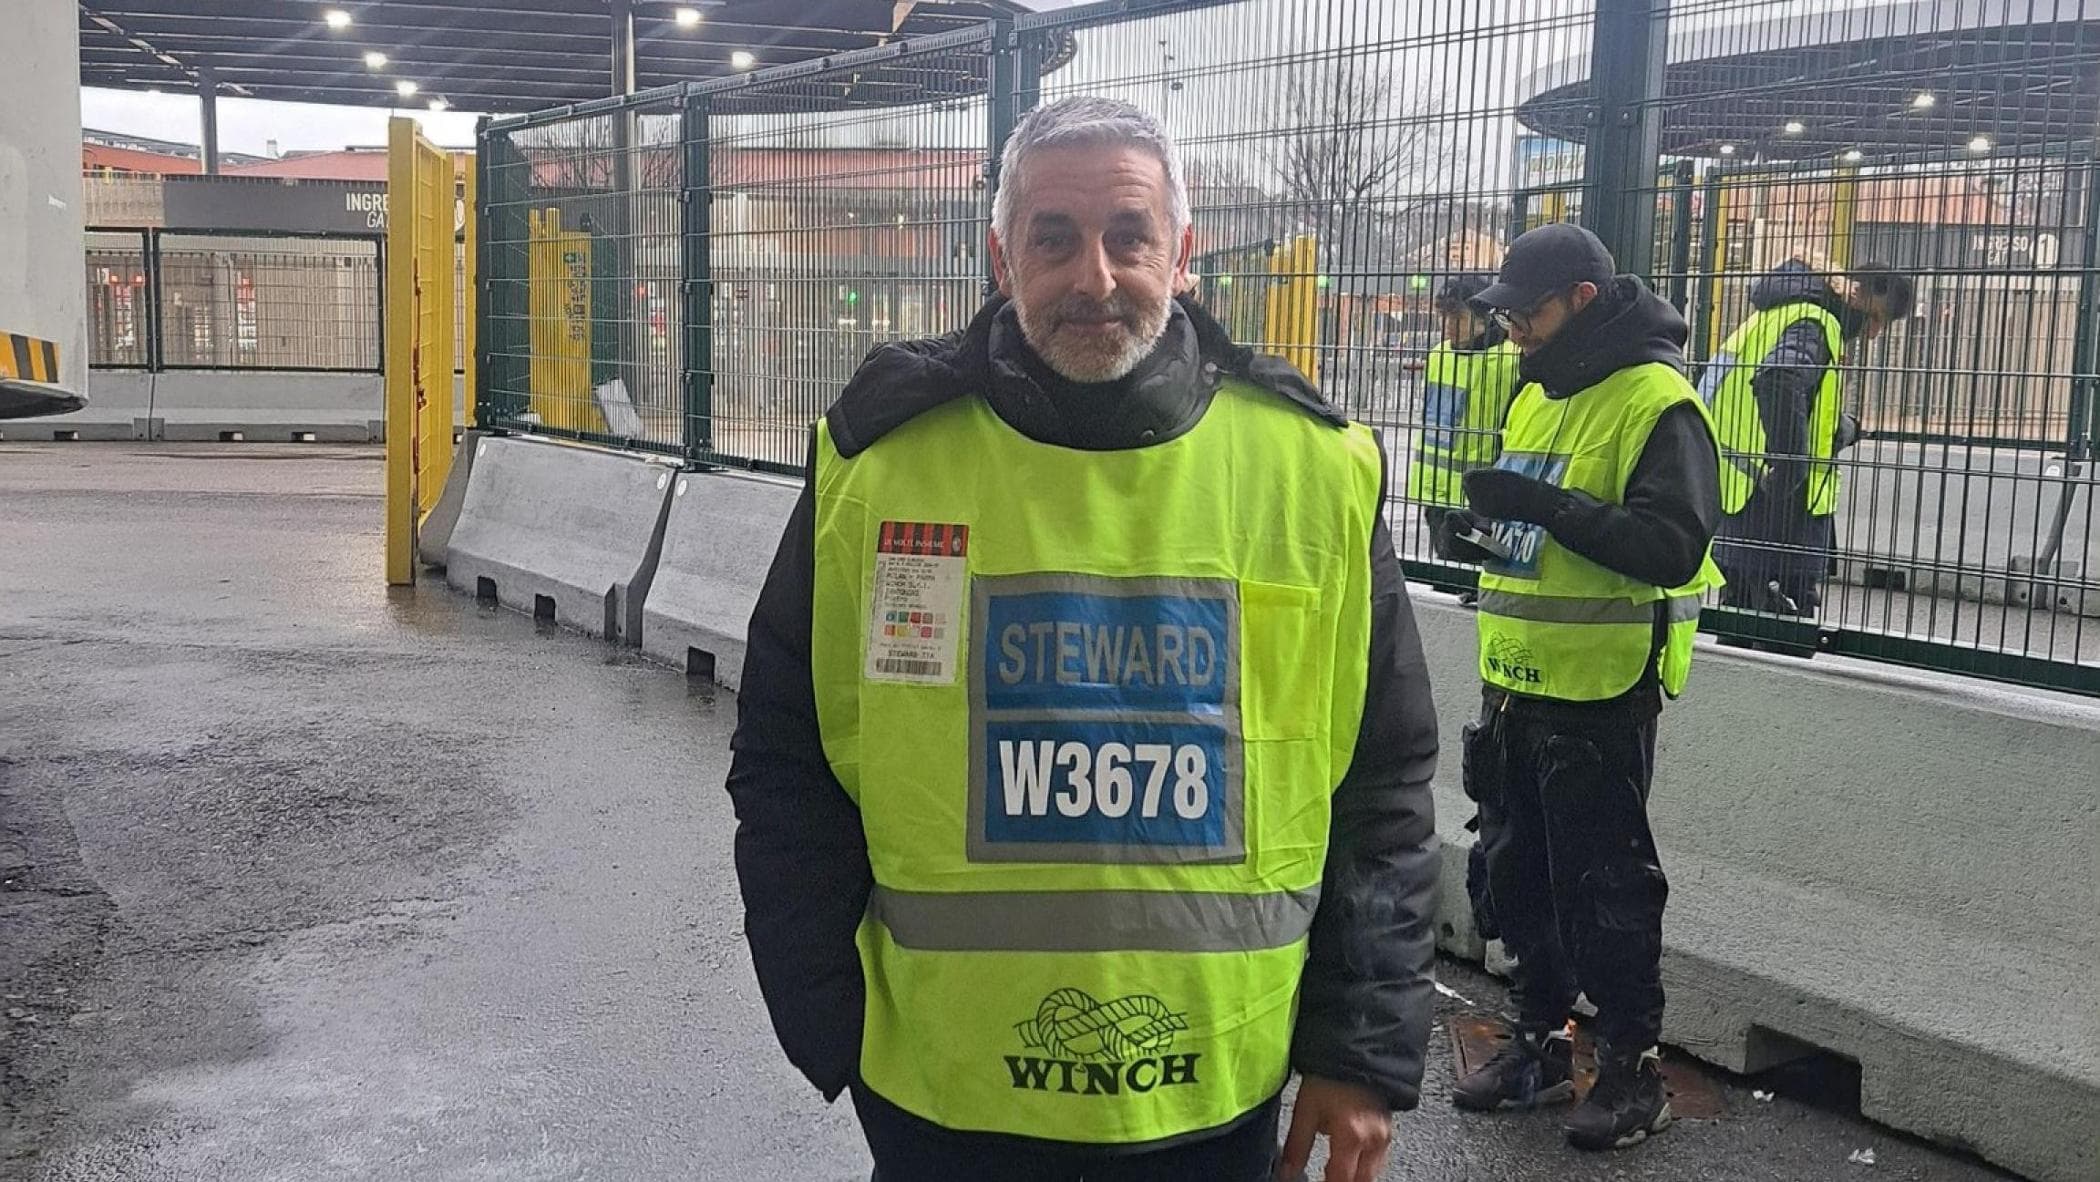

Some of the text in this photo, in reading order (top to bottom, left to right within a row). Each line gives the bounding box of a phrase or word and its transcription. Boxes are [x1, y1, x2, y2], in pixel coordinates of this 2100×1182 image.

[367, 211, 389, 228] GA
[999, 621, 1216, 687] STEWARD
[1488, 657, 1542, 683] WNCH
[999, 739, 1208, 820] W3678
[1003, 1052, 1202, 1095] WINCH
